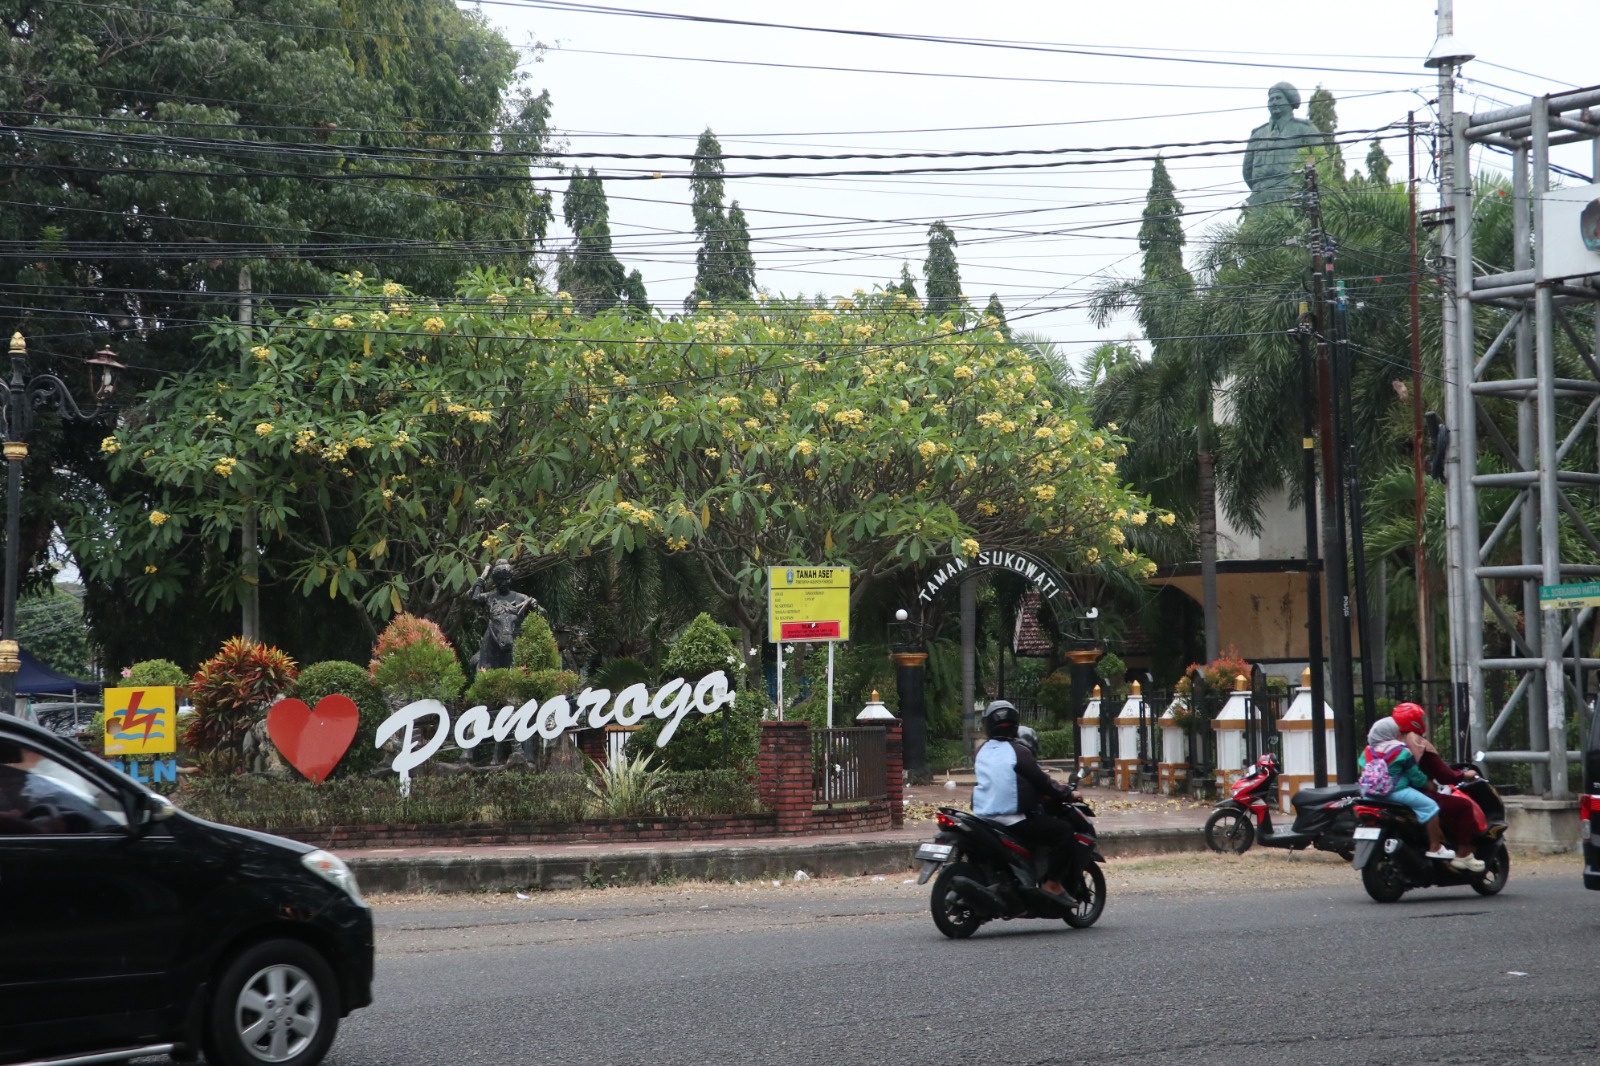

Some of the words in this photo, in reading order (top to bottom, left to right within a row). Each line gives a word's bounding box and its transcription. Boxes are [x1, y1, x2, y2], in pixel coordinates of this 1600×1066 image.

[796, 569, 817, 579] TANAH
[818, 569, 833, 578] ASET
[918, 557, 968, 602] TAMAN
[979, 551, 1060, 599] SUKOWATI
[375, 670, 736, 773] Ponorogo
